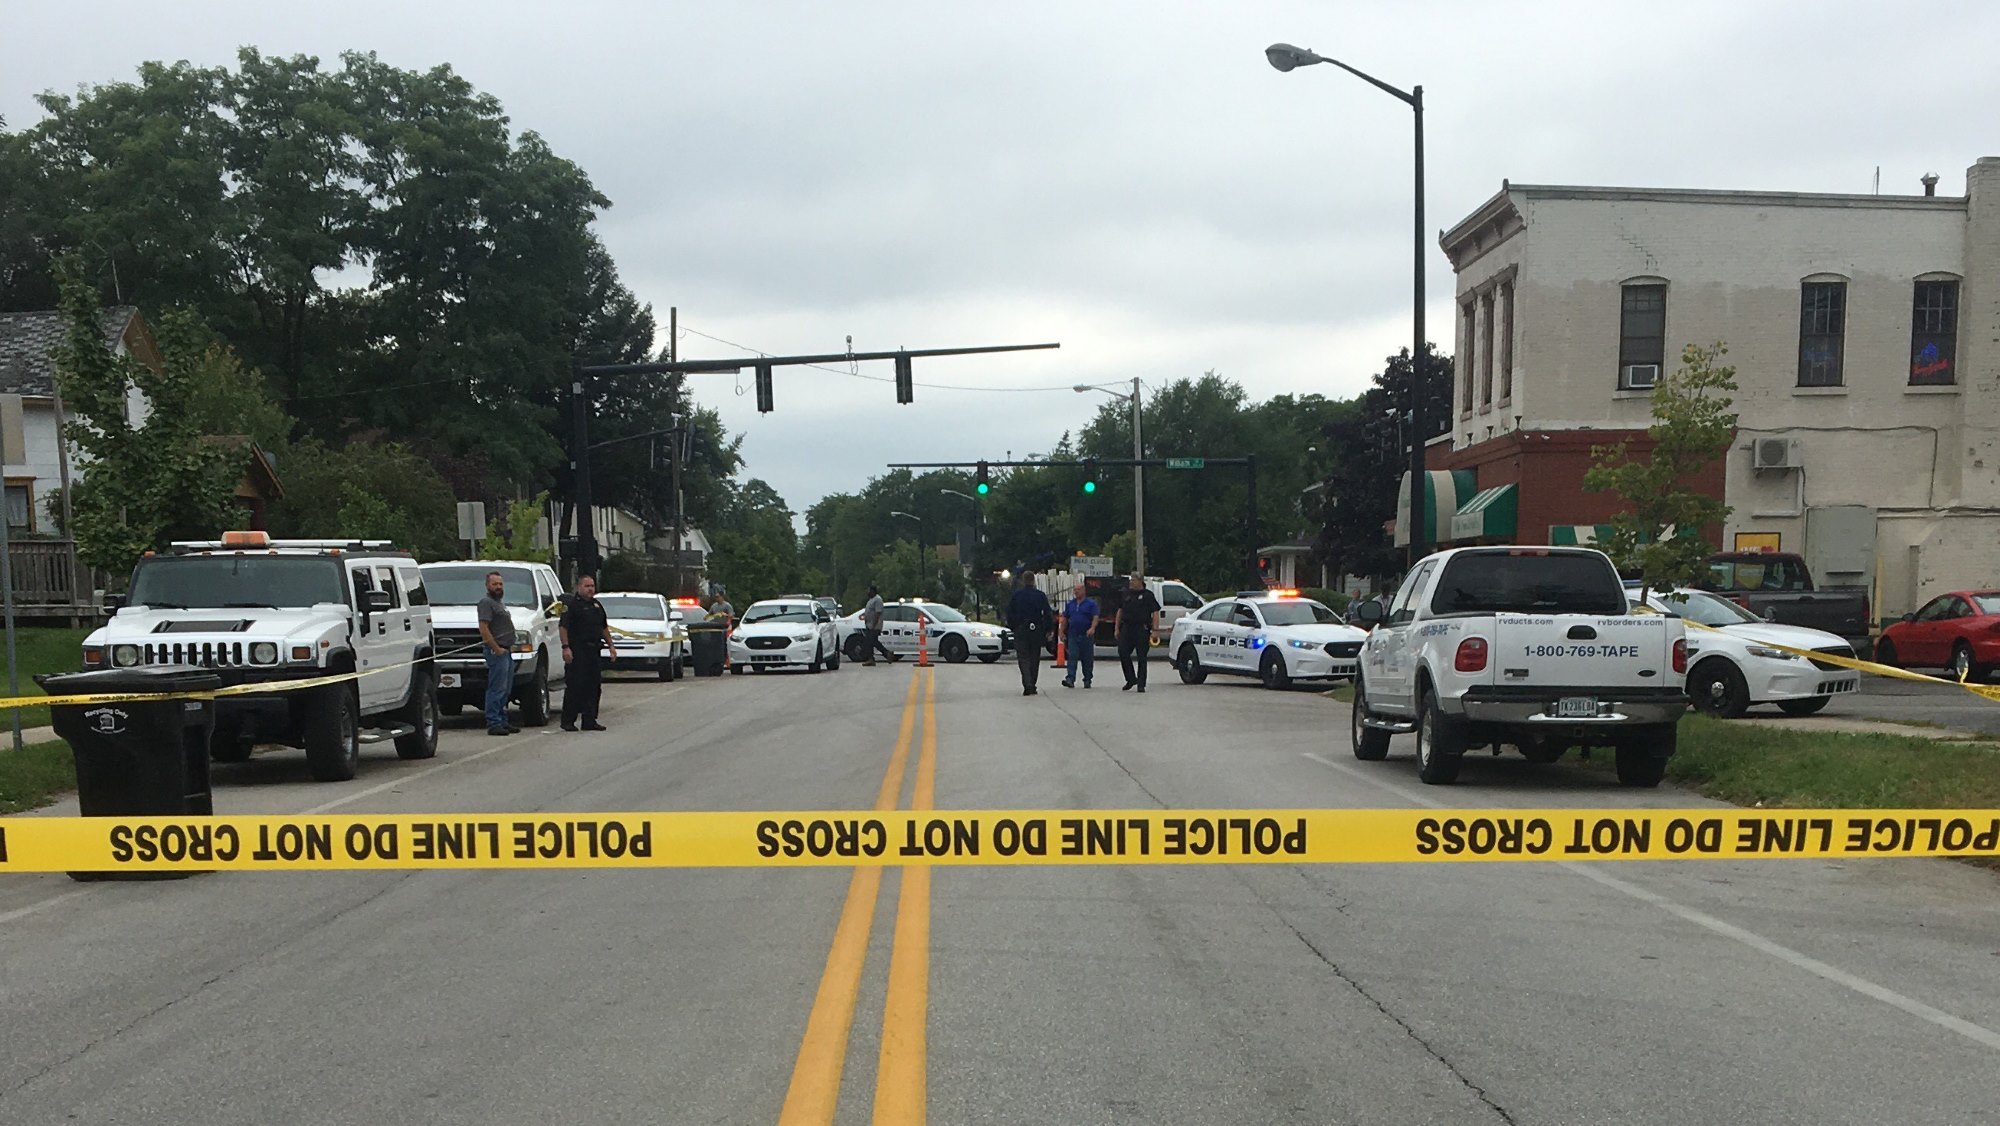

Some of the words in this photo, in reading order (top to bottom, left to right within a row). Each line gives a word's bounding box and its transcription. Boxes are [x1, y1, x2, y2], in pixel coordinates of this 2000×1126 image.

[1498, 618, 1554, 626] rvducts.com
[1597, 618, 1664, 627] rvborders.com
[1201, 635, 1245, 649] POLICE
[1524, 645, 1639, 658] 1-800-769-TAPE
[84, 707, 114, 718] Recycling
[114, 708, 129, 720] Only
[110, 825, 240, 862] CROSS
[253, 824, 332, 861] NOT
[345, 823, 399, 860] DO
[412, 823, 500, 860] LINE
[513, 822, 652, 859] POLICE
[757, 820, 887, 857] CROSS
[899, 820, 979, 857] NOT
[993, 819, 1047, 856] DO
[1060, 819, 1150, 855] LINE
[1163, 819, 1307, 855] POLICE
[1416, 819, 1553, 855] CROSS
[1564, 819, 1651, 854] NOT
[1665, 819, 1723, 853] DO
[1736, 819, 1833, 853] LINE
[1845, 818, 2000, 852] POLICE
